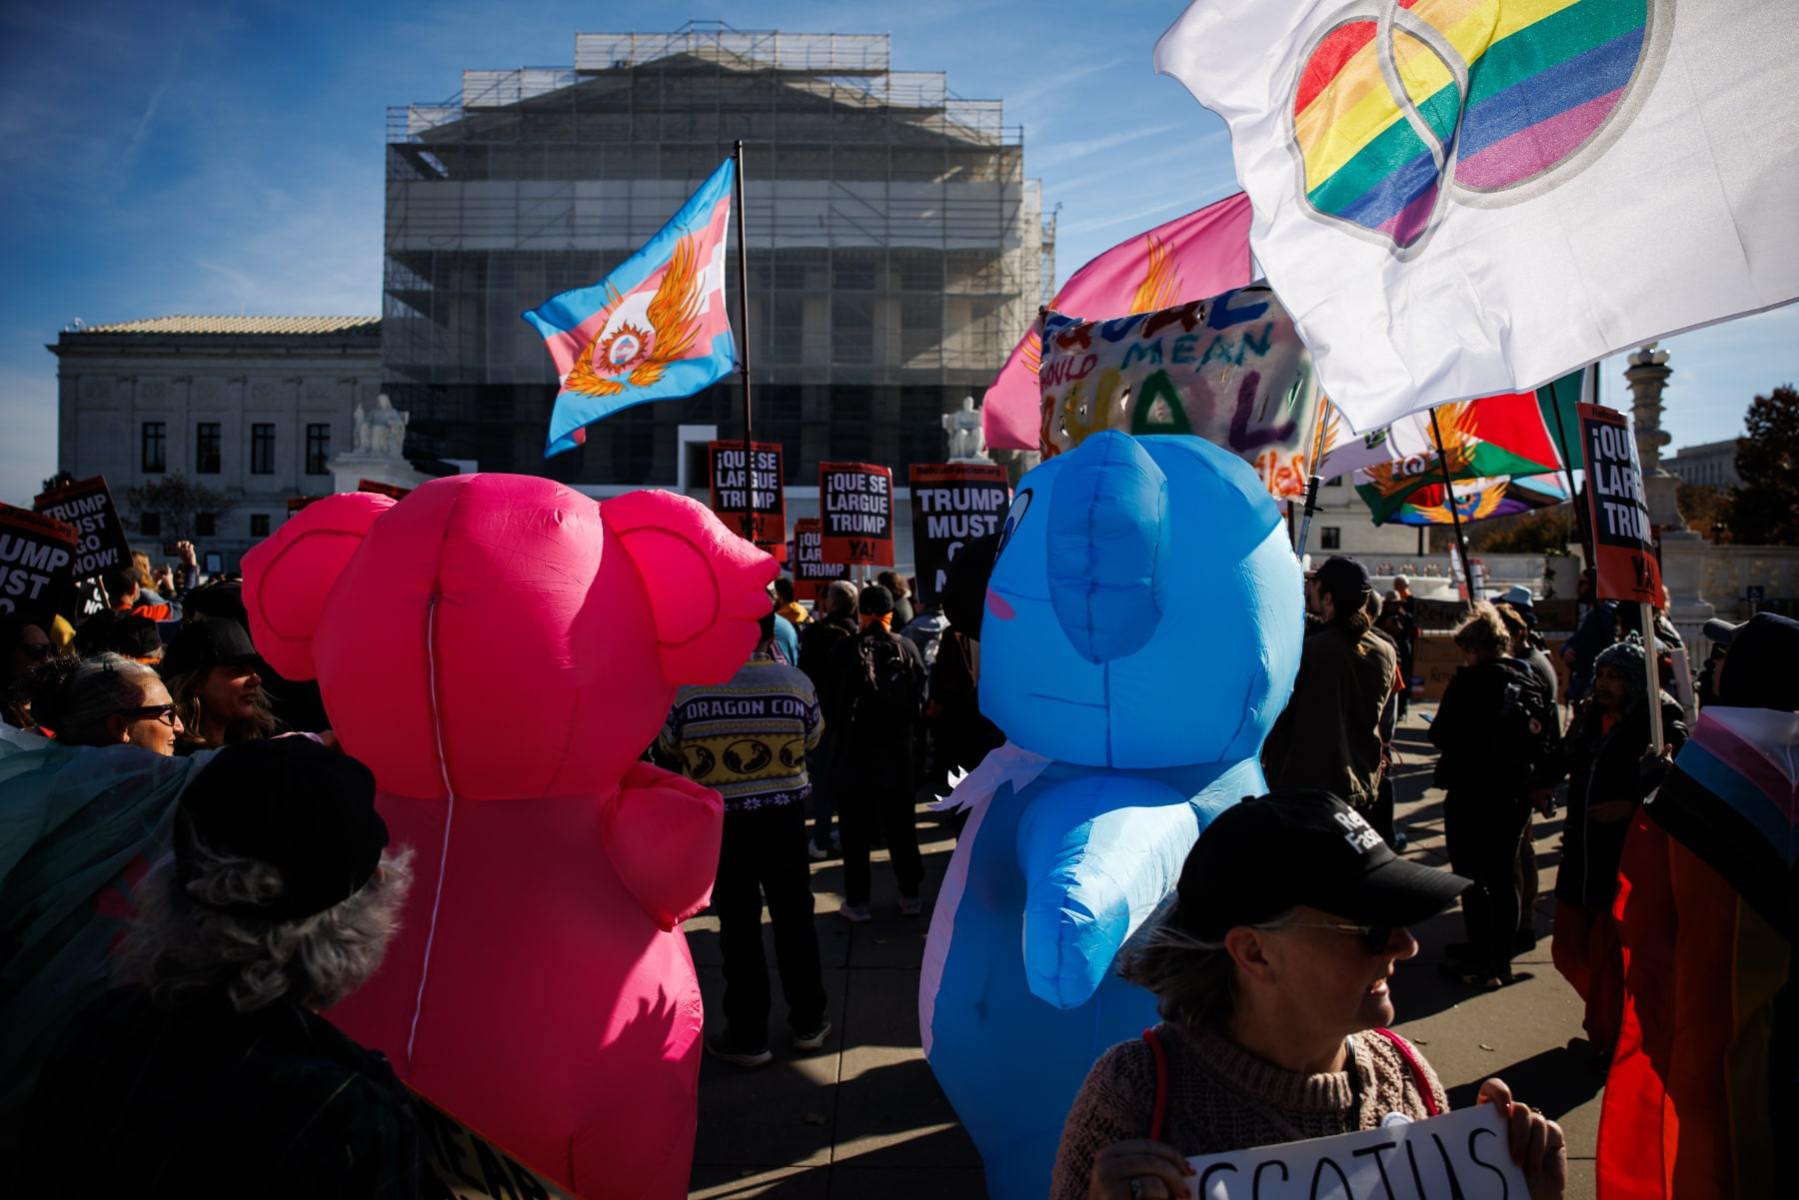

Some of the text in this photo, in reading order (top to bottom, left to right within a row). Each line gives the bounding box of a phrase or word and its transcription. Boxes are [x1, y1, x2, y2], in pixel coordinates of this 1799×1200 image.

[1120, 322, 1274, 372] MEAN
[1592, 425, 1634, 462] ¡QU
[757, 452, 777, 470] SE
[827, 473, 888, 495] ¡QUE SE
[826, 493, 888, 514] LARGUE
[916, 488, 1005, 512] TRUMP
[829, 514, 887, 534] TRUMP
[927, 514, 999, 539] MUST
[1603, 502, 1648, 543] TRU
[800, 532, 821, 547] ¡QU
[0, 533, 70, 573] UMP
[72, 547, 119, 576] NOW!
[801, 563, 846, 578] TRUMP
[686, 699, 805, 720] DRAGON CON
